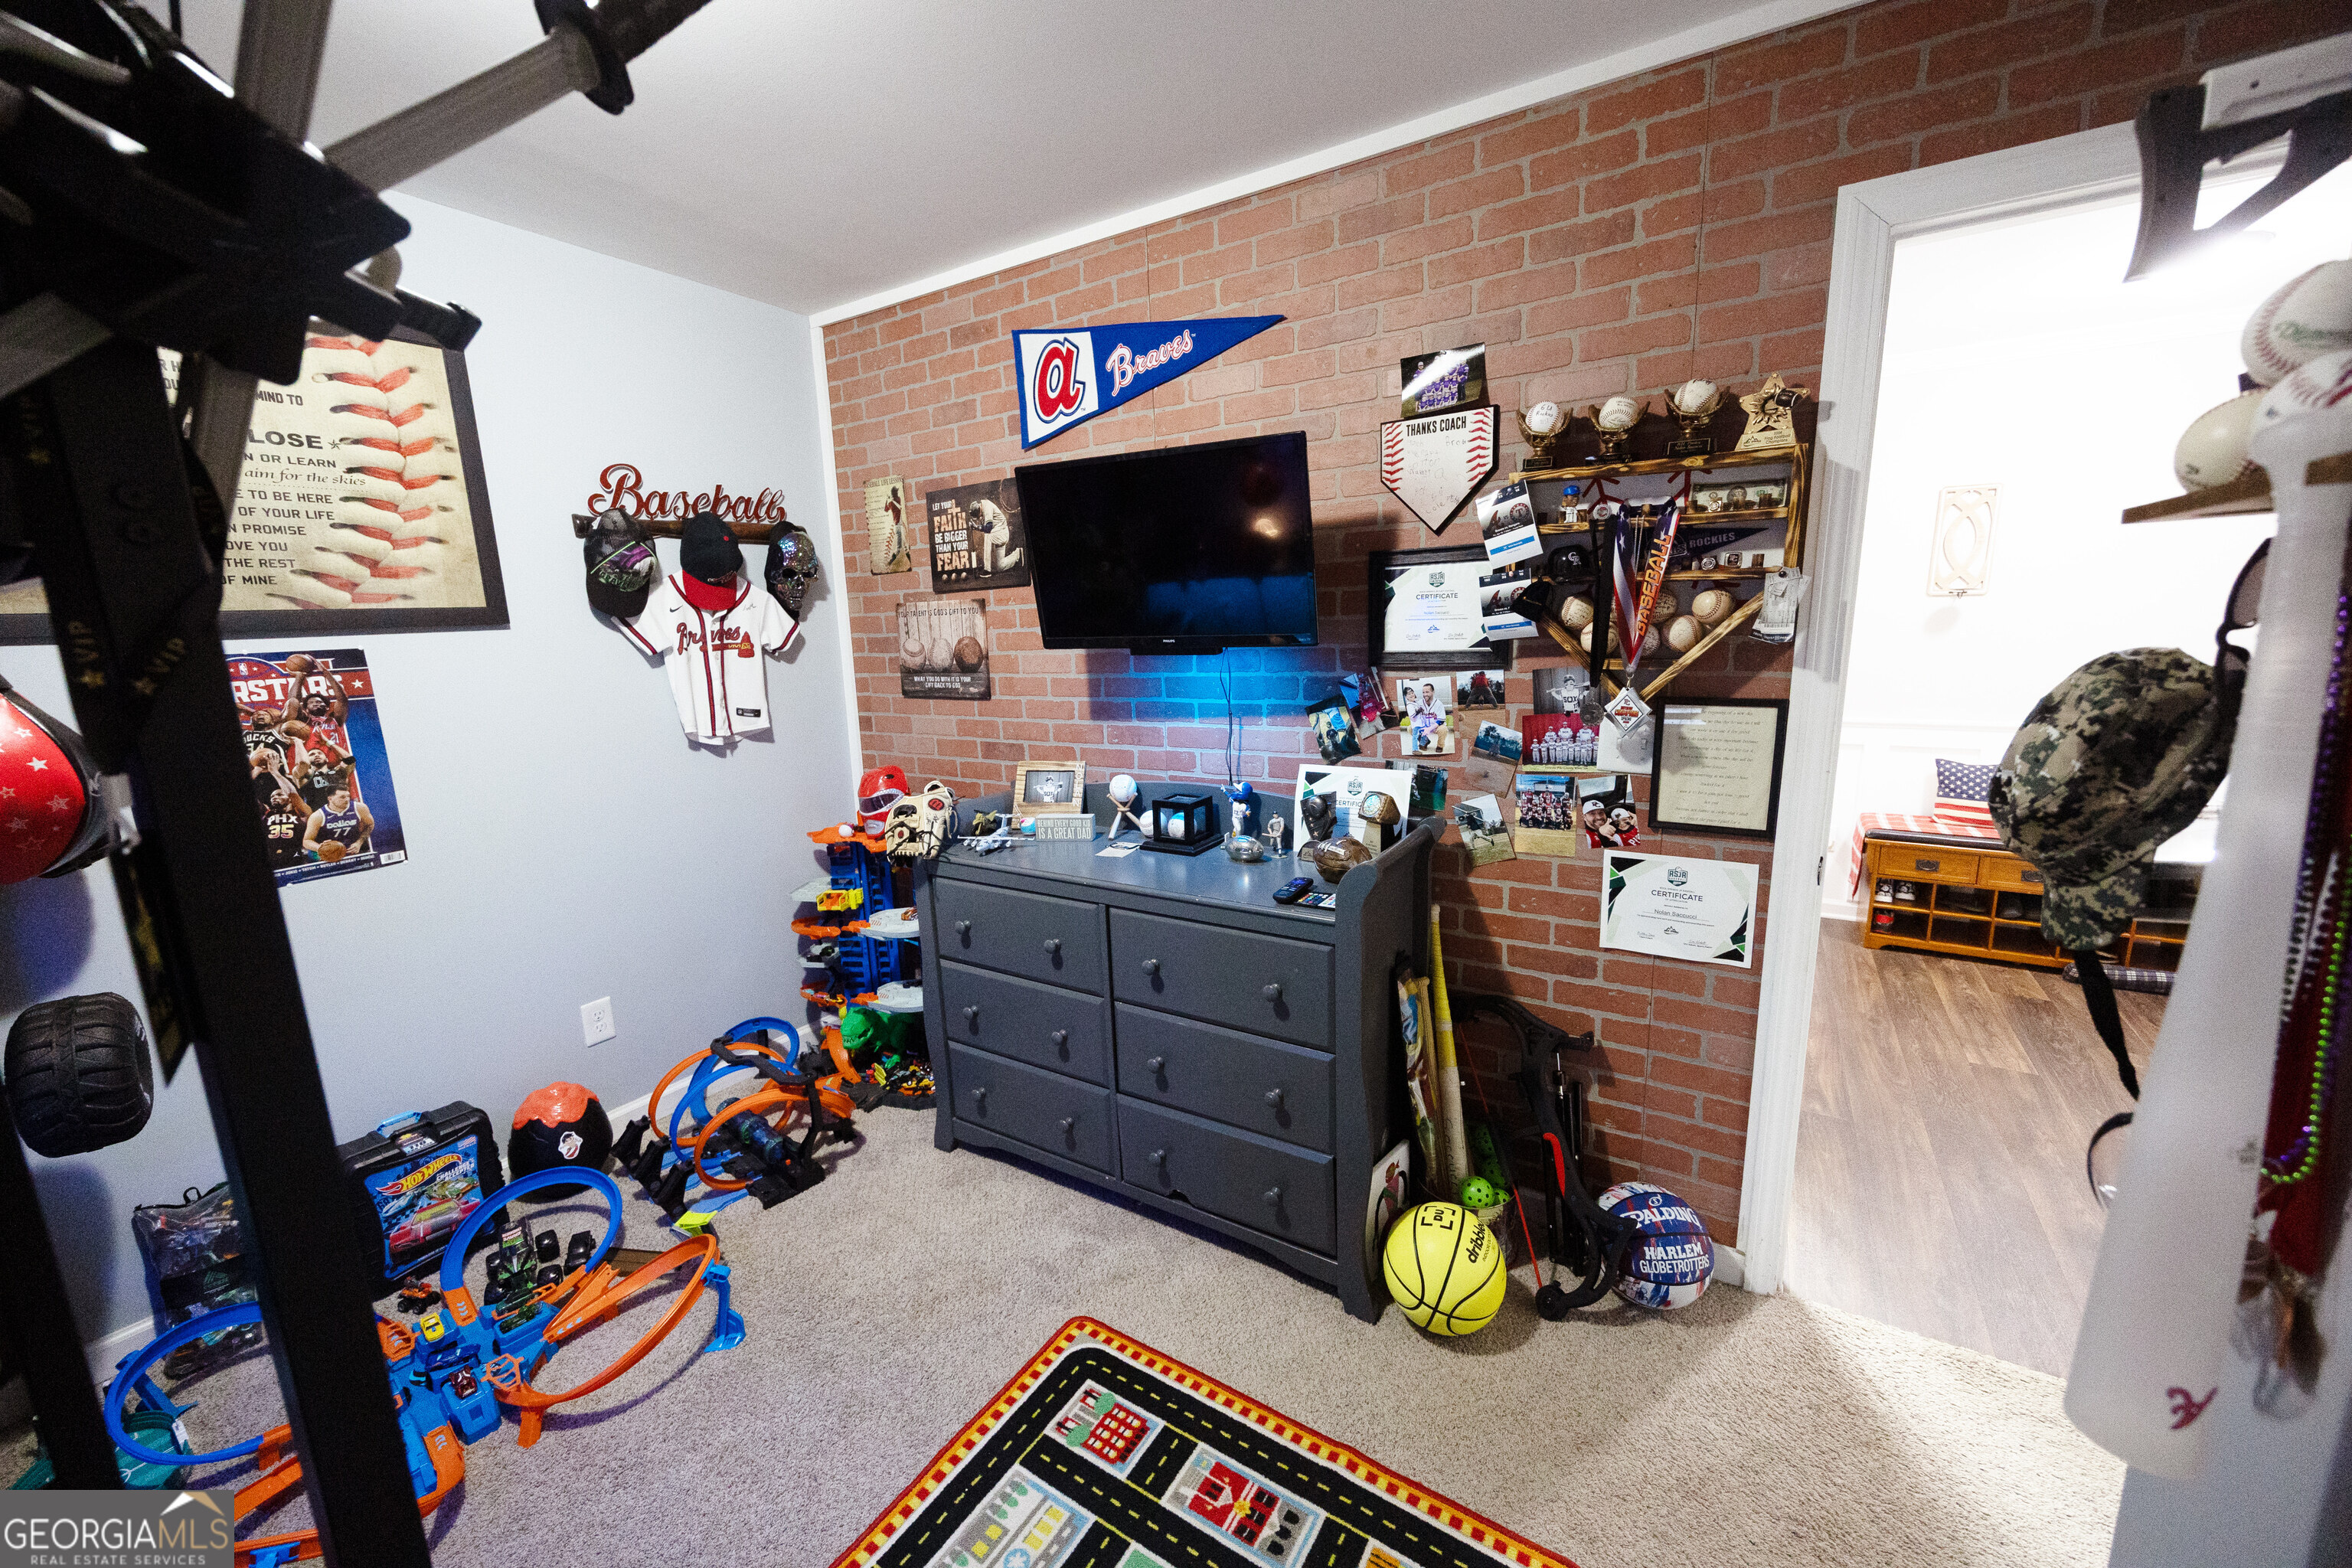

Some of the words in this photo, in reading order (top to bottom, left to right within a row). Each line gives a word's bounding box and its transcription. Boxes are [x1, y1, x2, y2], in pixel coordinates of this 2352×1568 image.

[1106, 328, 1193, 396] Braves
[256, 390, 283, 404] MIND
[286, 394, 304, 406] TO
[1406, 420, 1437, 436] THANKS
[1439, 416, 1466, 432] COACH
[247, 429, 323, 449] LOSE
[260, 453, 281, 464] OR
[287, 456, 336, 469] LEARN
[244, 468, 275, 479] aim
[272, 468, 304, 483] for
[306, 471, 328, 483] the
[332, 474, 366, 486] skies
[247, 490, 267, 500] TO
[273, 492, 292, 502] BE
[297, 493, 333, 505] HERE
[587, 463, 787, 524] Baseball
[941, 500, 952, 510] YOUR
[237, 507, 257, 517] OF
[262, 508, 301, 519] YOUR
[306, 510, 335, 521] LIFE
[934, 505, 967, 533] FAITH
[243, 524, 307, 536] PROMISE
[935, 533, 943, 544] BE
[944, 529, 968, 543] BIGGER
[227, 541, 254, 551] OVE
[258, 541, 288, 552] YOU
[936, 542, 951, 553] THAN
[952, 541, 969, 551] YOUR
[1689, 531, 1736, 548] ROCKIES
[225, 558, 253, 568] THE
[259, 558, 296, 568] REST
[936, 550, 969, 571] FEAR
[242, 575, 277, 585] MINE
[1637, 534, 1671, 635] BASEBALL
[234, 675, 344, 703] RSTRS
[1072, 763, 1083, 807] NOLAN
[267, 814, 299, 825] PHX
[268, 824, 295, 839] 35
[333, 827, 351, 838] 77
[1038, 828, 1045, 839] IS
[1047, 828, 1053, 839] A
[1054, 828, 1074, 839] GREAT
[1076, 828, 1091, 839] DAD
[1669, 870, 1687, 879] RSJR
[1651, 890, 1704, 902] CERTIFICATE
[1671, 911, 1697, 920] Saccucci
[401, 1169, 423, 1191] HOT
[1433, 1209, 1445, 1222] DU
[1465, 1221, 1486, 1263] dribble
[1644, 1242, 1704, 1260] HARLEM
[1639, 1254, 1710, 1274] GLOBETROTTERS
